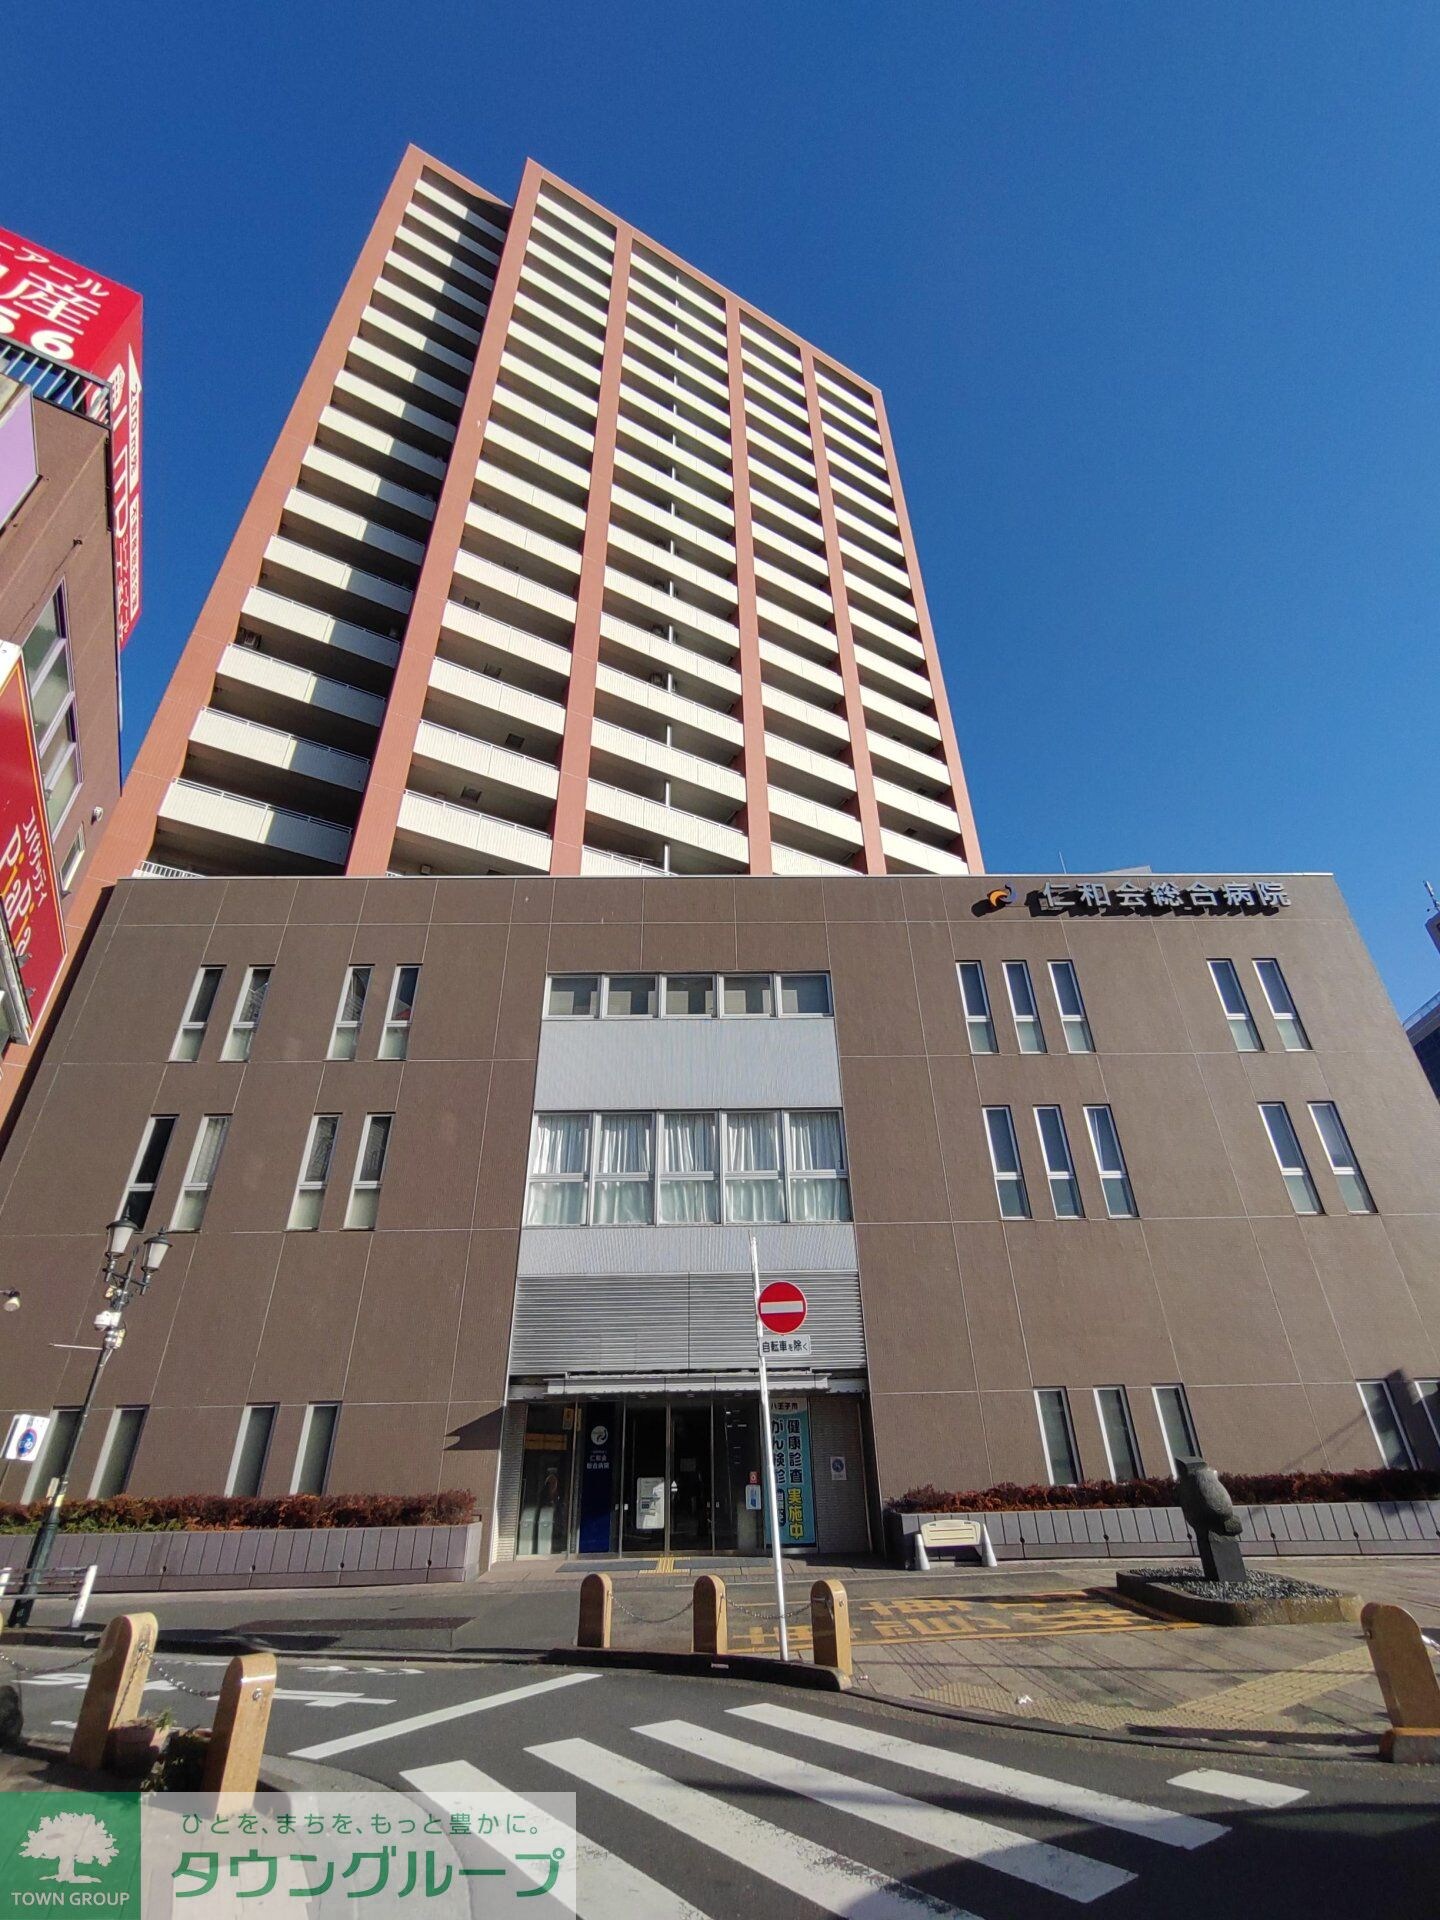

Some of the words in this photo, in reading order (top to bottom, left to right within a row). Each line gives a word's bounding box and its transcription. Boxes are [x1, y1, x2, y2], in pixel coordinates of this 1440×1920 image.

[1043, 881, 1292, 907] 仁和会総合病院
[762, 1339, 808, 1353] 自転車を除く
